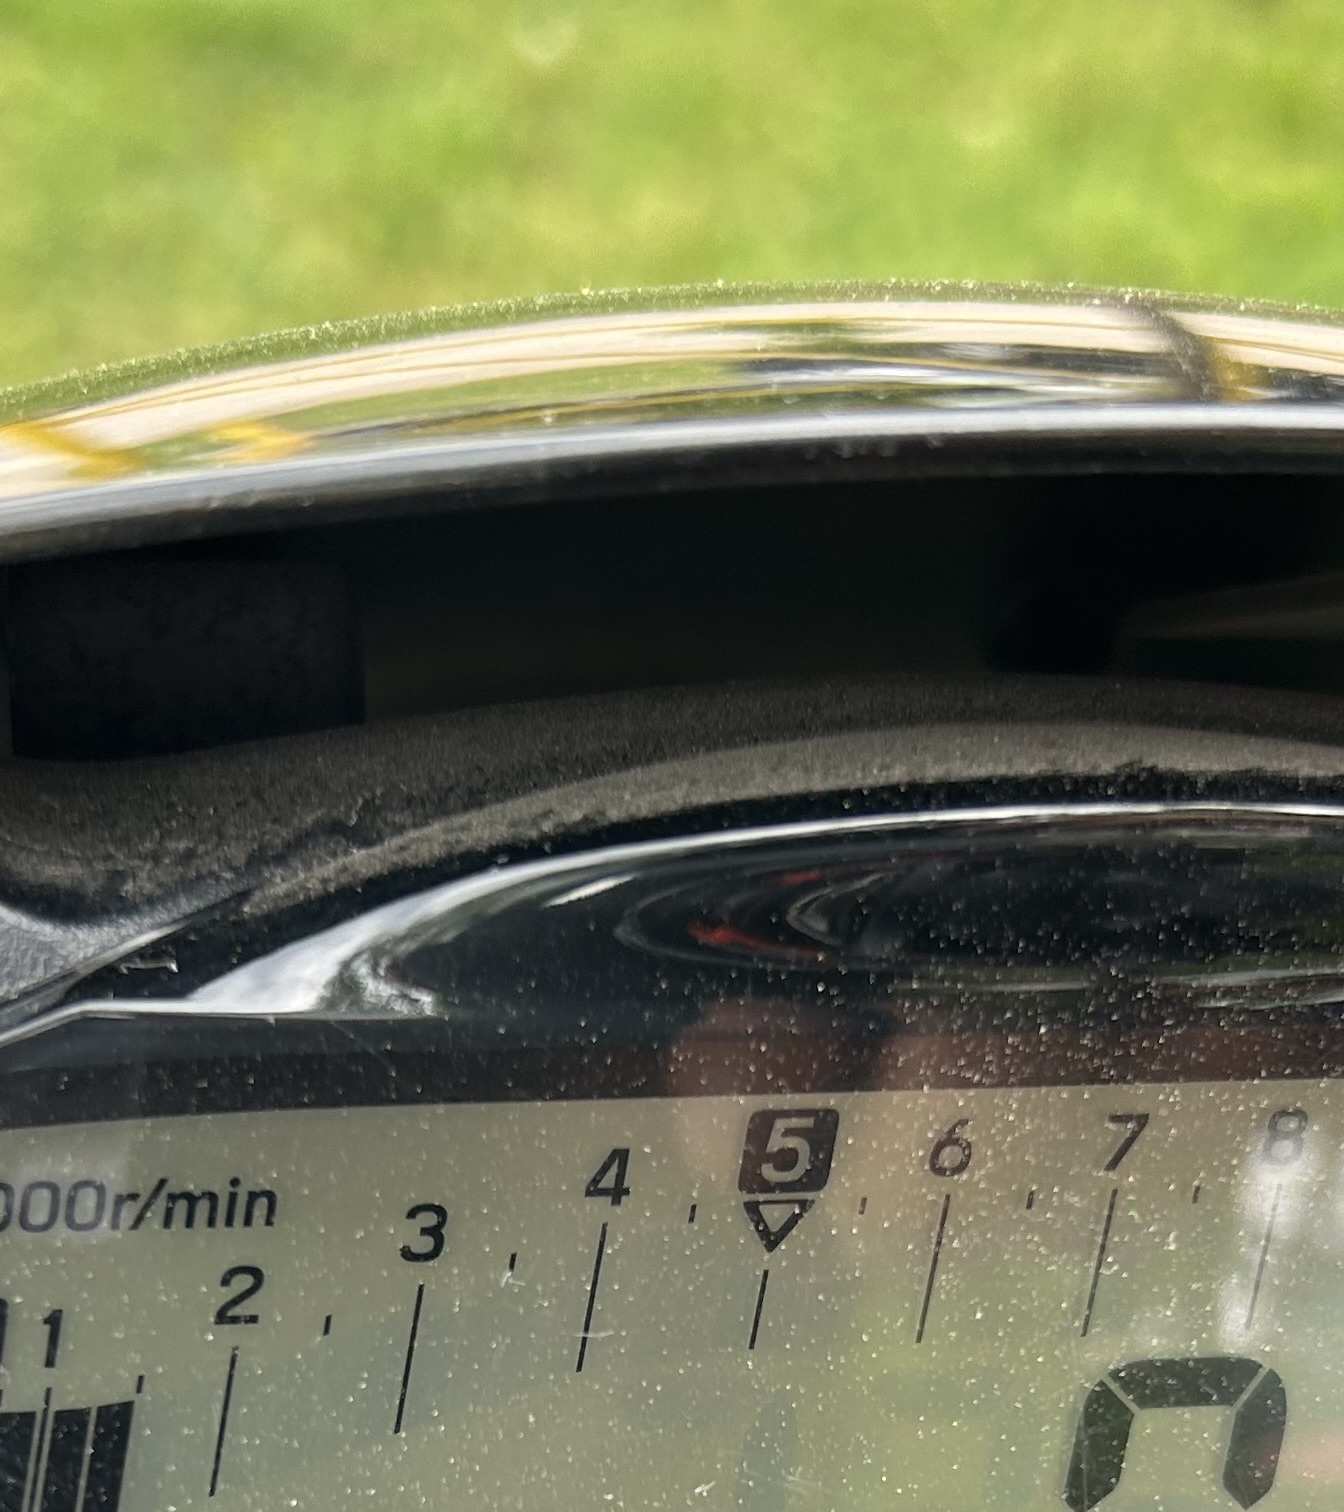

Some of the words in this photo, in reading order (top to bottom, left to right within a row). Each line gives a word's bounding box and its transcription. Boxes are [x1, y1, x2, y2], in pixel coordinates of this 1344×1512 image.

[42, 1308, 65, 1368] 1
[213, 1265, 266, 1327] 2
[399, 1203, 449, 1264] 3
[583, 1147, 632, 1207] 4
[760, 1116, 817, 1184] 5
[927, 1118, 974, 1179] 6
[1102, 1112, 1151, 1173] 7
[1260, 1107, 1309, 1166] 8
